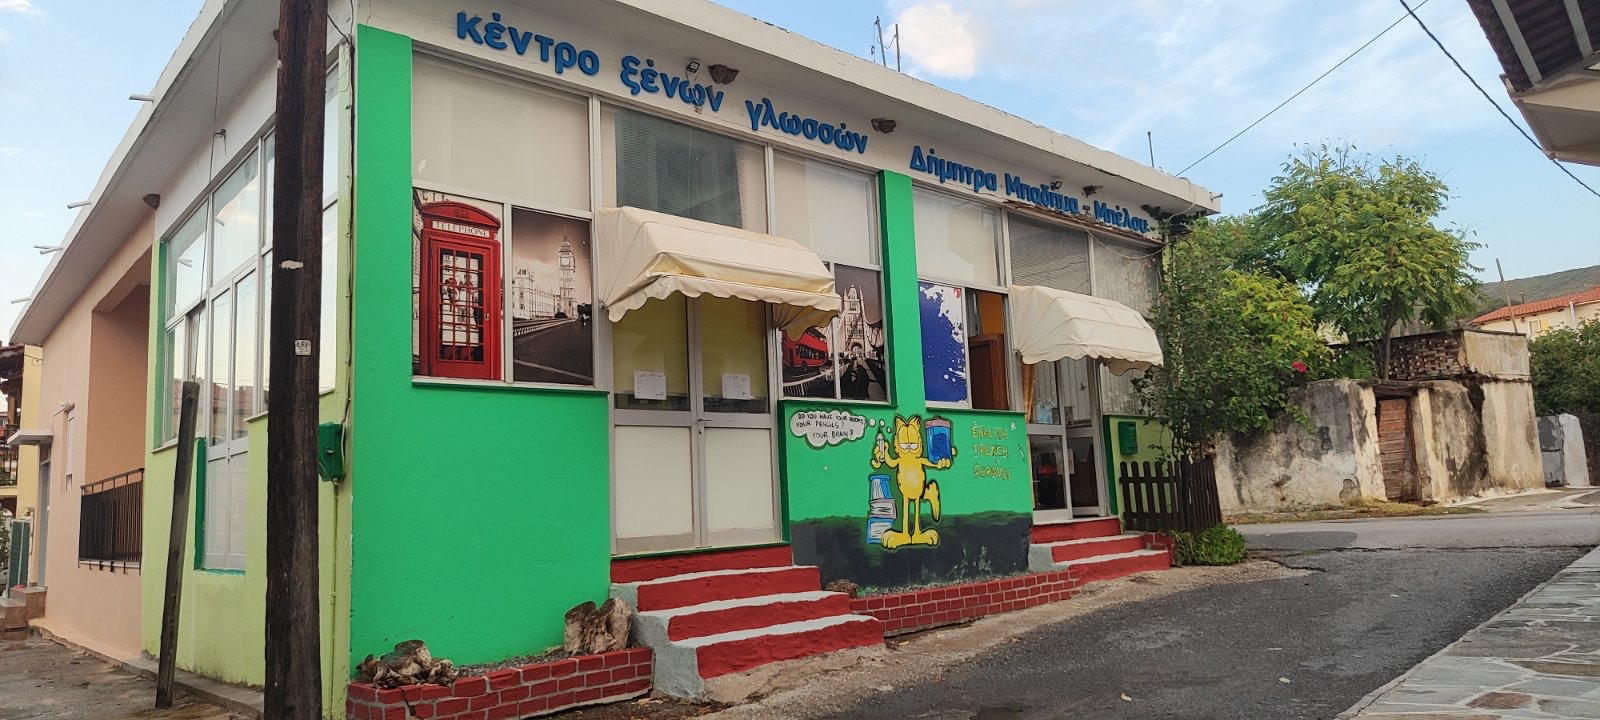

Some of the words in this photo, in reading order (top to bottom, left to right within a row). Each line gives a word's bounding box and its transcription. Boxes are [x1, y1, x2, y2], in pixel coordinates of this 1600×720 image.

[456, 11, 600, 76] κέντρο
[619, 55, 725, 112] ξένων
[745, 97, 868, 154] γλωσσών
[910, 145, 997, 193] Δήμητρα
[434, 220, 489, 238] TELEPHONE
[812, 431, 829, 439] YOUR
[971, 424, 1009, 440] ENGLISH
